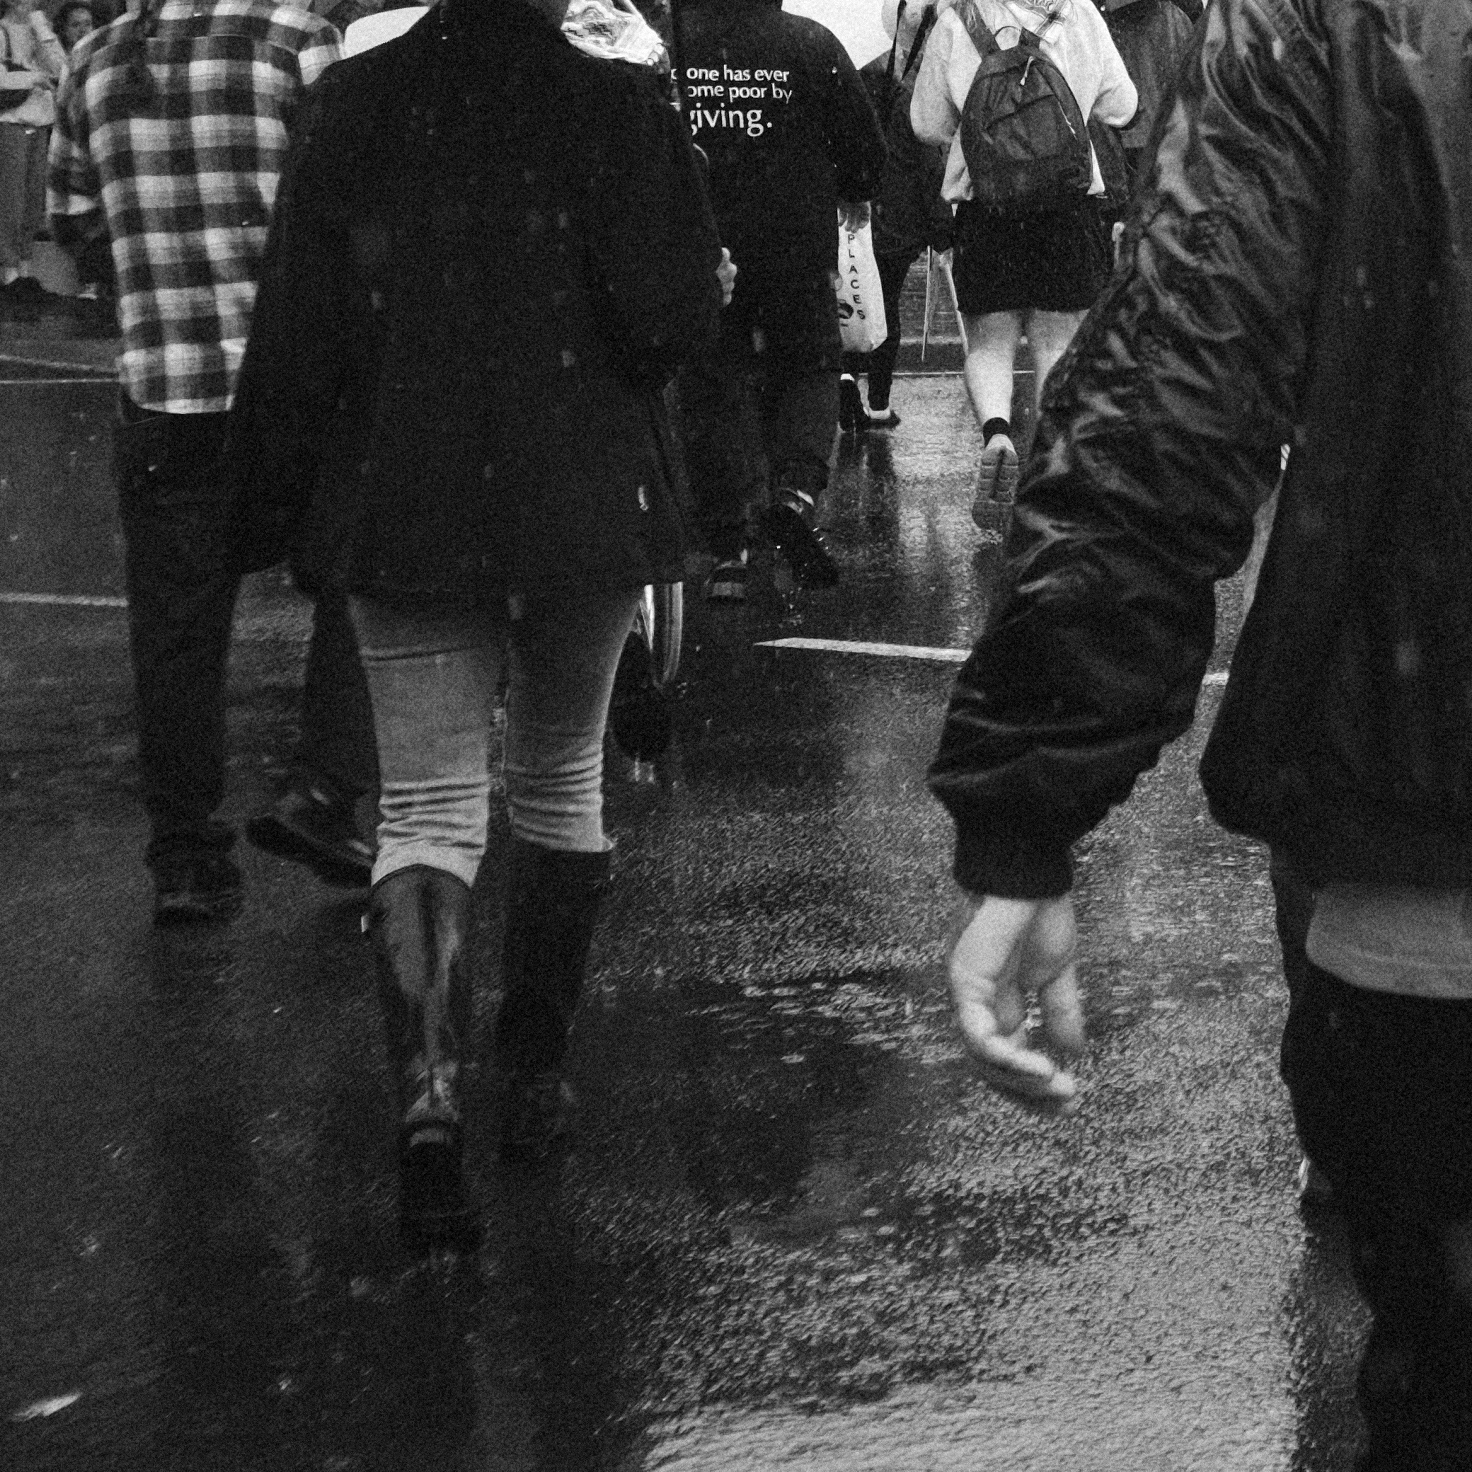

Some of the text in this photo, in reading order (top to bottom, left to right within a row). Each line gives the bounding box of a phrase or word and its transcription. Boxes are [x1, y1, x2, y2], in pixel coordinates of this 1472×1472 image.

[686, 67, 720, 81] one
[723, 64, 751, 81] has
[754, 69, 790, 83] ever
[687, 82, 793, 104] ome poor by
[846, 233, 866, 320] PLACES
